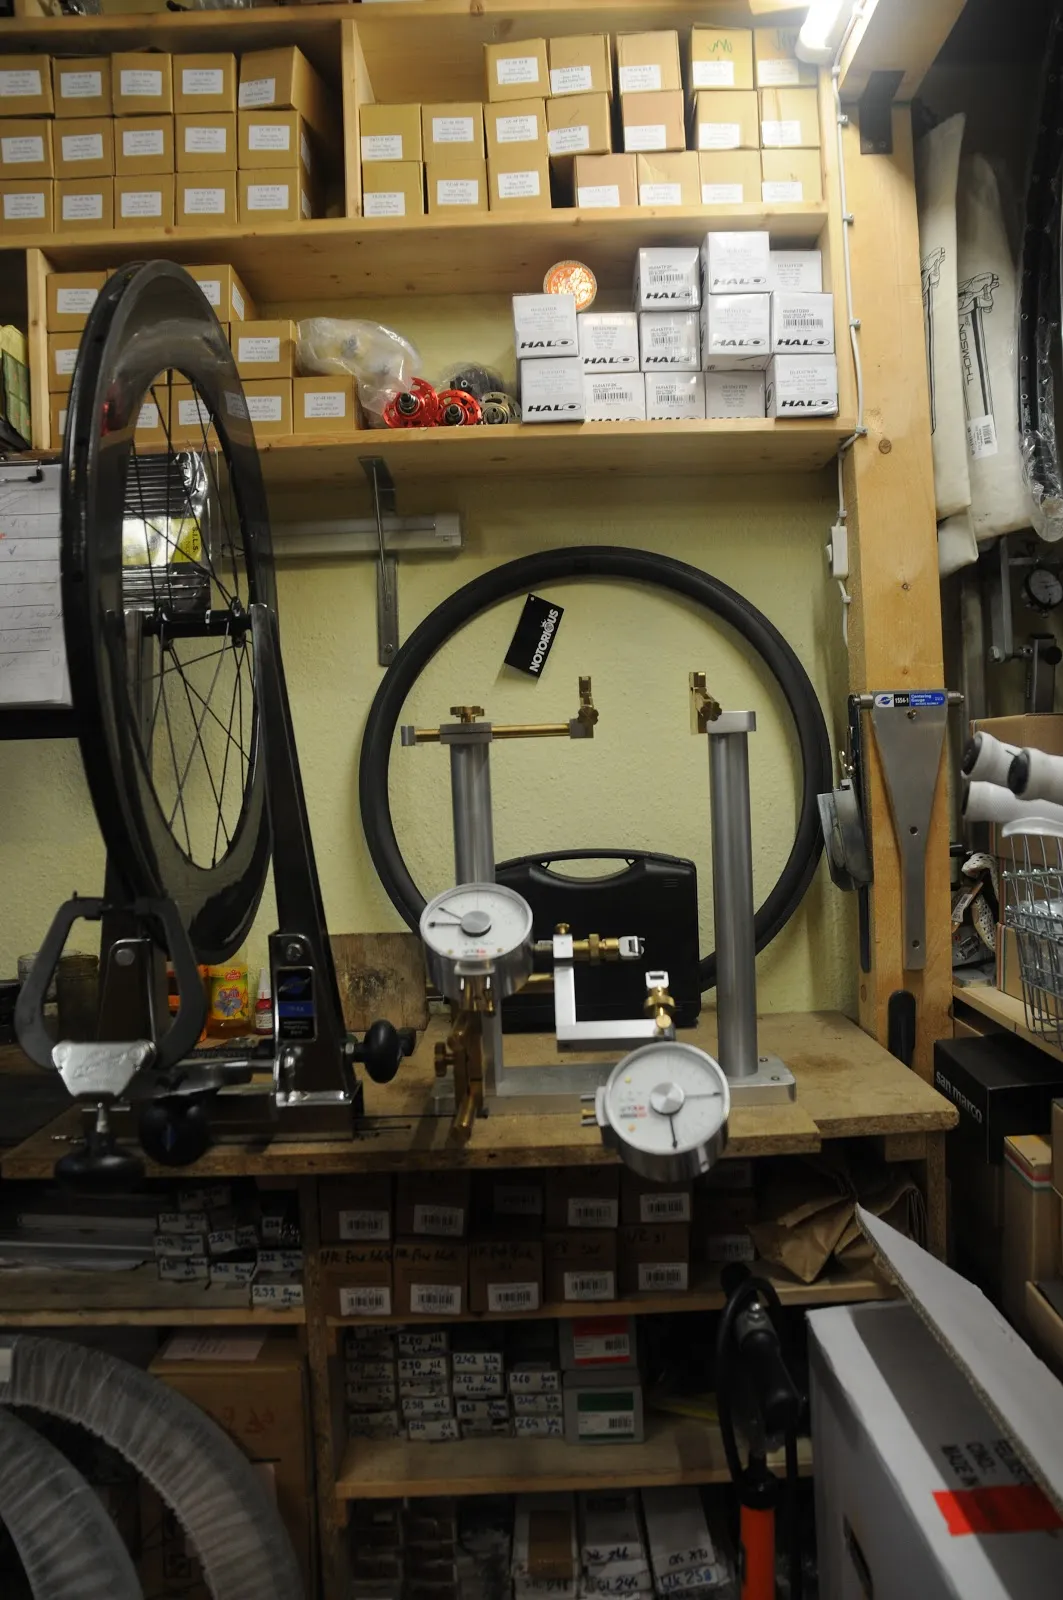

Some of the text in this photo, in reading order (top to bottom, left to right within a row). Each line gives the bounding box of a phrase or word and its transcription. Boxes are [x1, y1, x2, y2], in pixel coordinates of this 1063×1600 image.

[713, 276, 767, 286] HALO
[645, 291, 692, 300] HALO
[520, 338, 575, 349] HALO
[713, 337, 766, 347] HALO
[777, 338, 830, 347] HALO
[584, 355, 636, 364] HALO
[645, 355, 692, 364] HALO
[959, 323, 974, 386] THOMSON
[528, 402, 582, 412] HALO
[781, 398, 835, 408] HALO
[528, 608, 559, 672] NOTORIOUS
[936, 1070, 982, 1124] san marco
